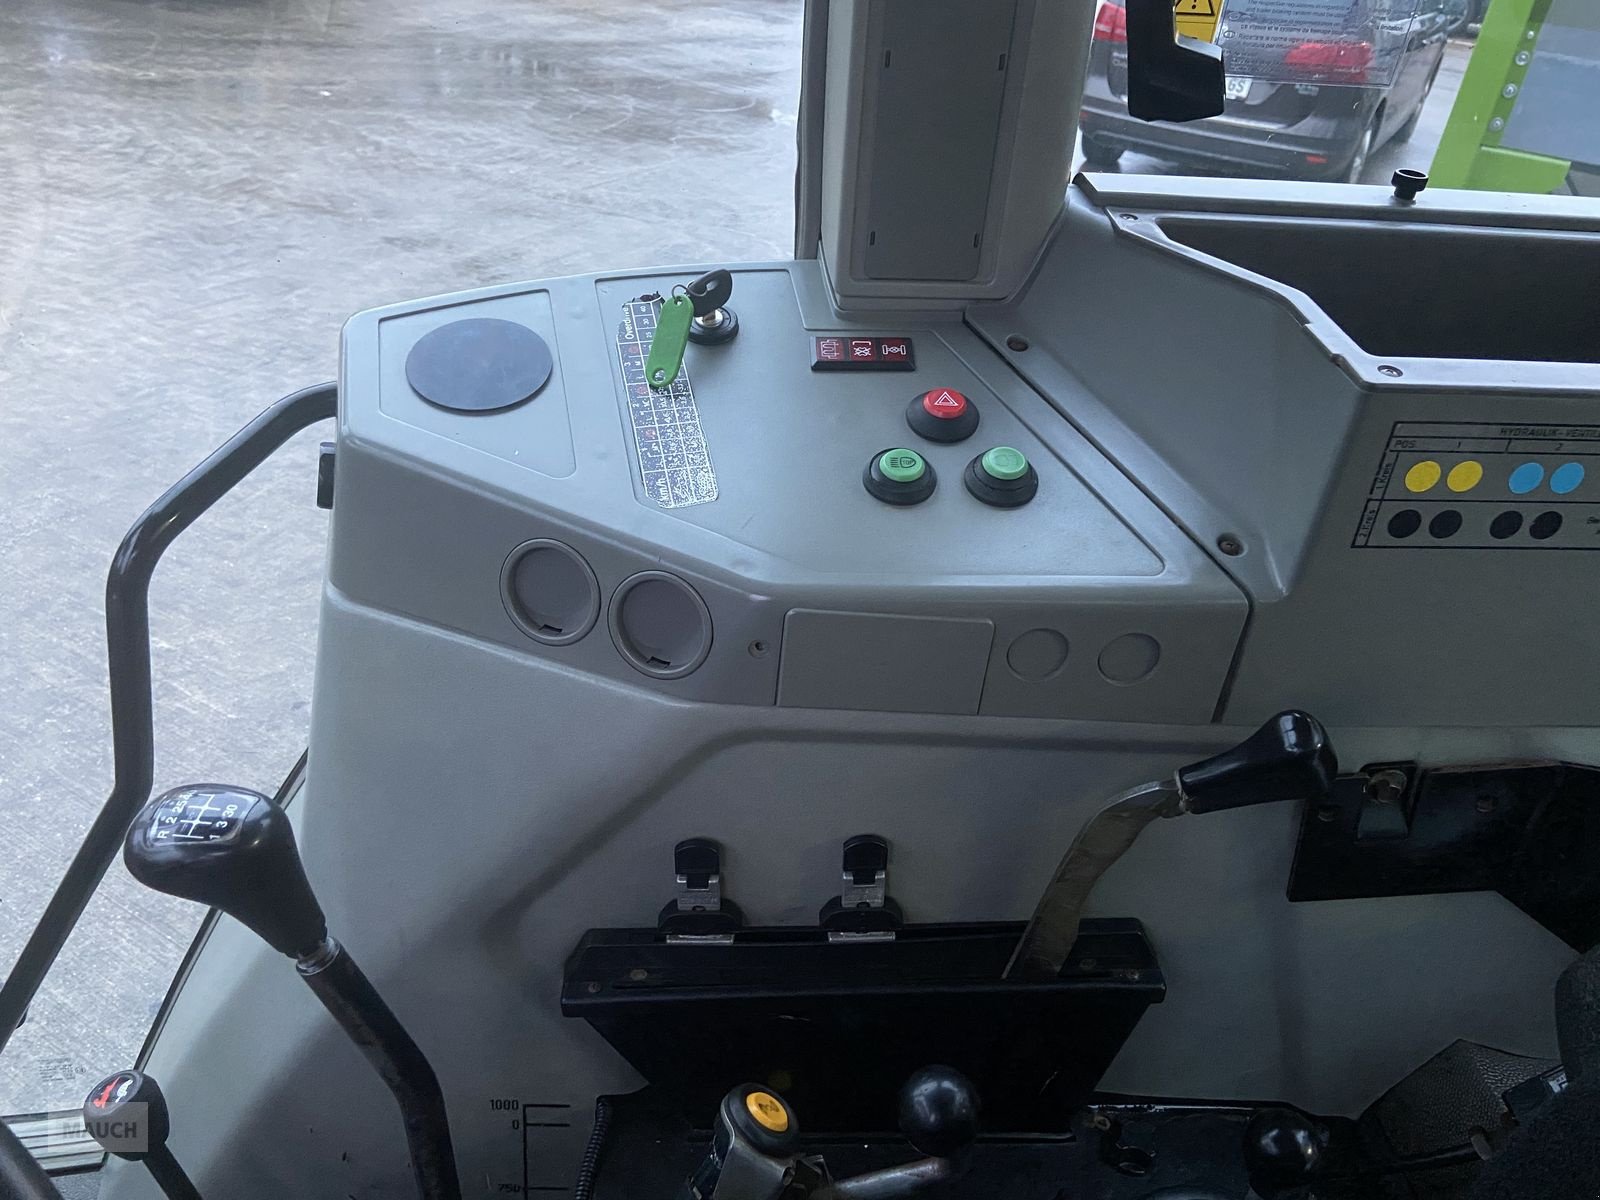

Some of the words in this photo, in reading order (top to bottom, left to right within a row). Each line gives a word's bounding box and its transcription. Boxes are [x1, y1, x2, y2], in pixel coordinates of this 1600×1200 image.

[172, 800, 188, 813] 25
[222, 804, 238, 818] 30
[165, 816, 178, 824] 2
[157, 829, 170, 839] R
[490, 1099, 519, 1111] 1000
[512, 1120, 519, 1130] 0
[498, 1183, 520, 1193] 750
